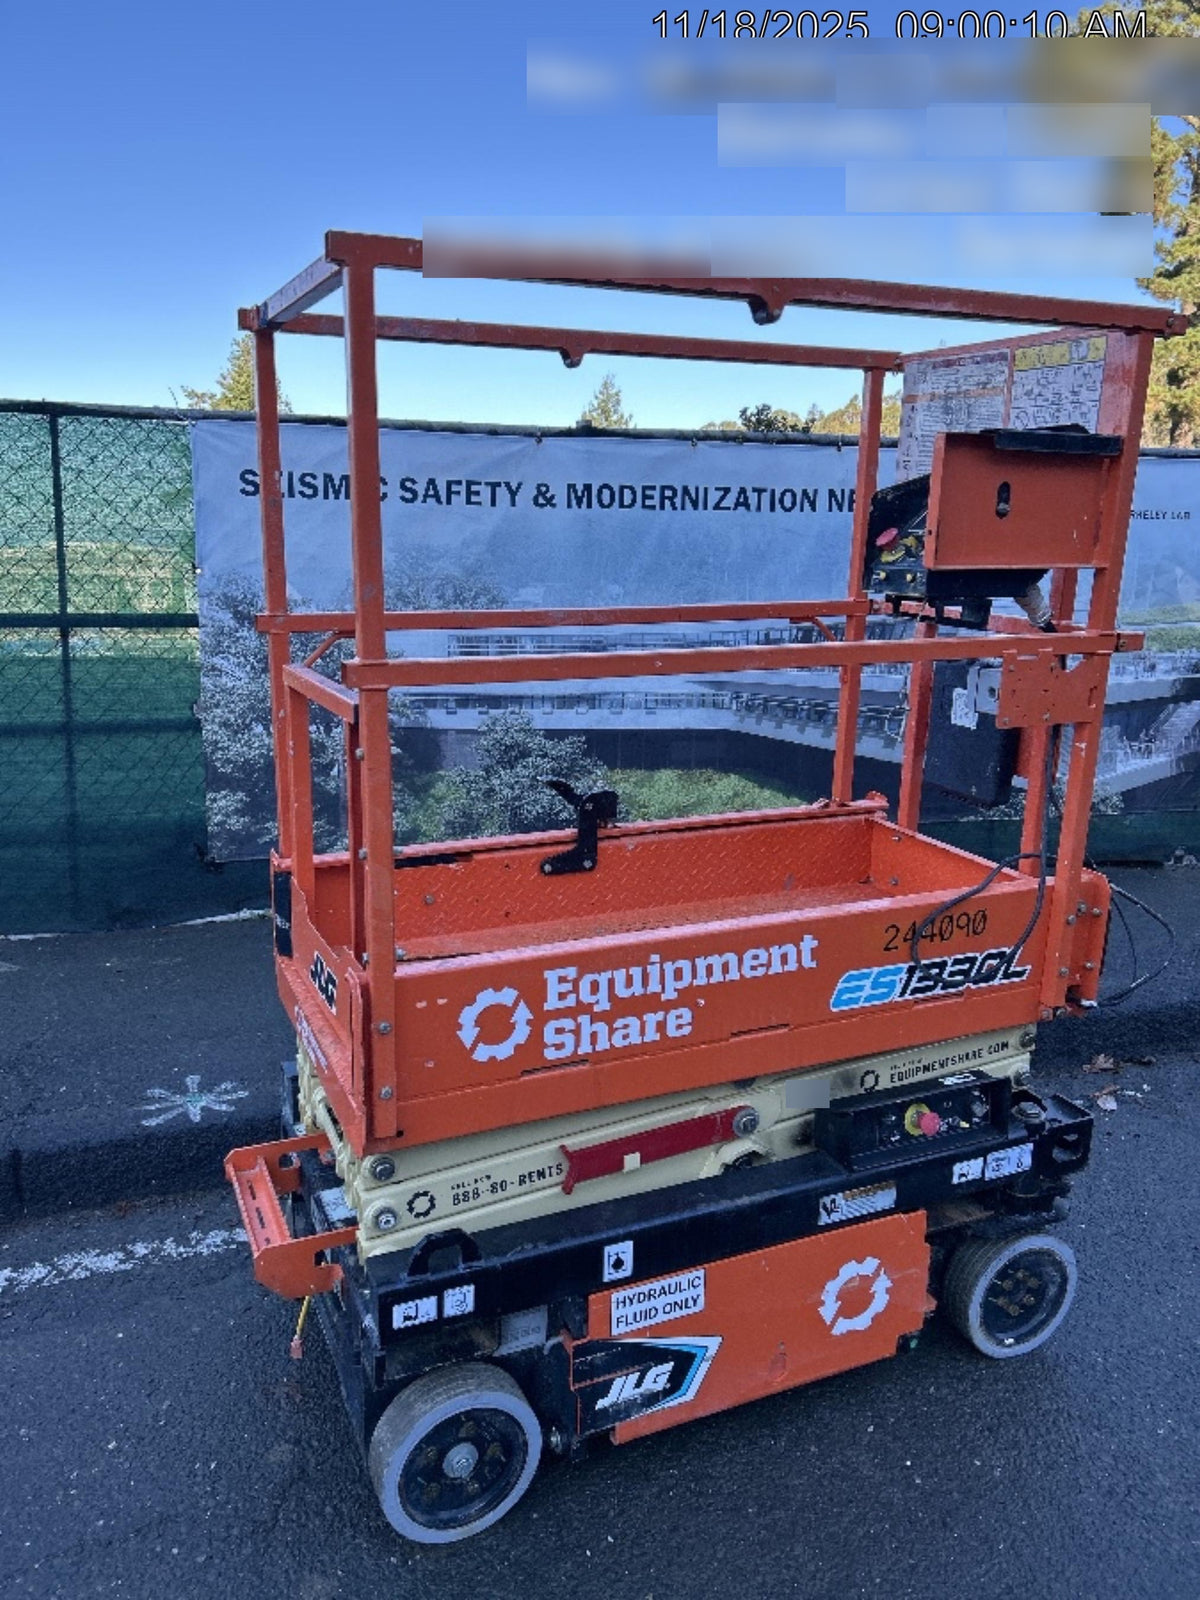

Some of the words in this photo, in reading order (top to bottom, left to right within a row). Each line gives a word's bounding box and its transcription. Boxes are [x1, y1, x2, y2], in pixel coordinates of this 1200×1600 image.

[239, 468, 388, 502] SISM
[399, 476, 523, 507] SAFETY
[532, 482, 557, 509] &
[566, 483, 818, 513] MODERNIZATION
[883, 908, 988, 952] 244090
[543, 934, 819, 1012] Equipment
[543, 1006, 693, 1060] Share
[615, 1275, 702, 1310] HYDRAULIC
[616, 1307, 659, 1329] FLUID
[662, 1294, 701, 1315] ONLY
[595, 1361, 675, 1410] JLG
